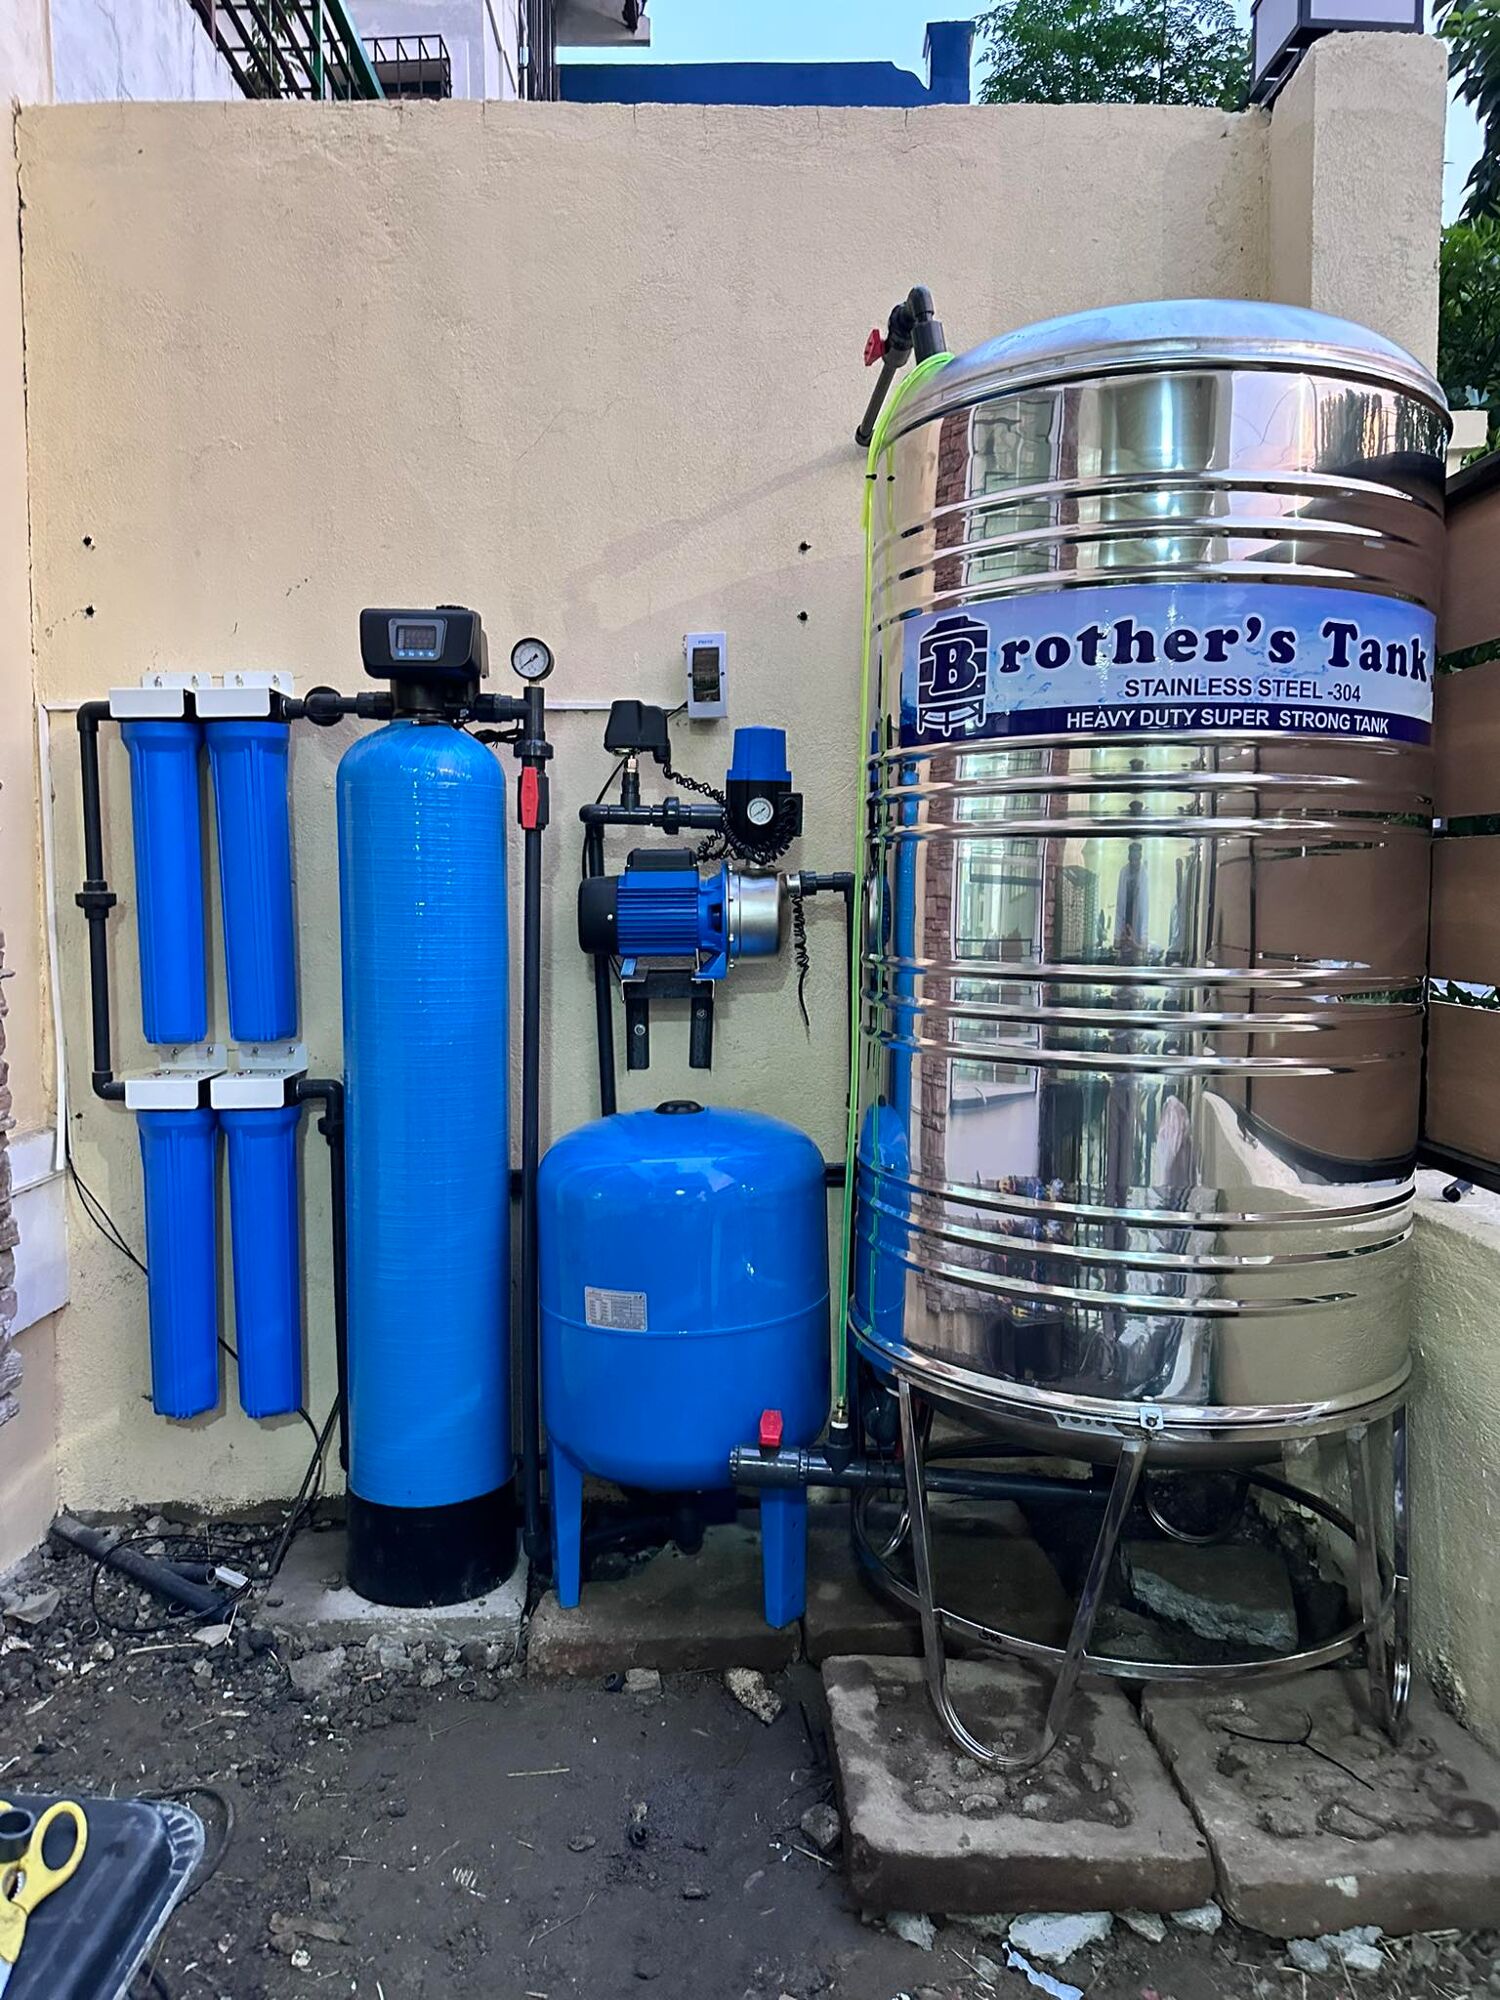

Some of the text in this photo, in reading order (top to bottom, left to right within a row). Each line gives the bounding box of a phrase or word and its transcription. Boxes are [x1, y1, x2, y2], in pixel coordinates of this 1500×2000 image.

[931, 617, 1296, 693] Brother's
[1125, 678, 1361, 702] STAINLESS STEEL -304
[1067, 708, 1389, 734] HEAVY DUTY SUPER STRONG TANK
